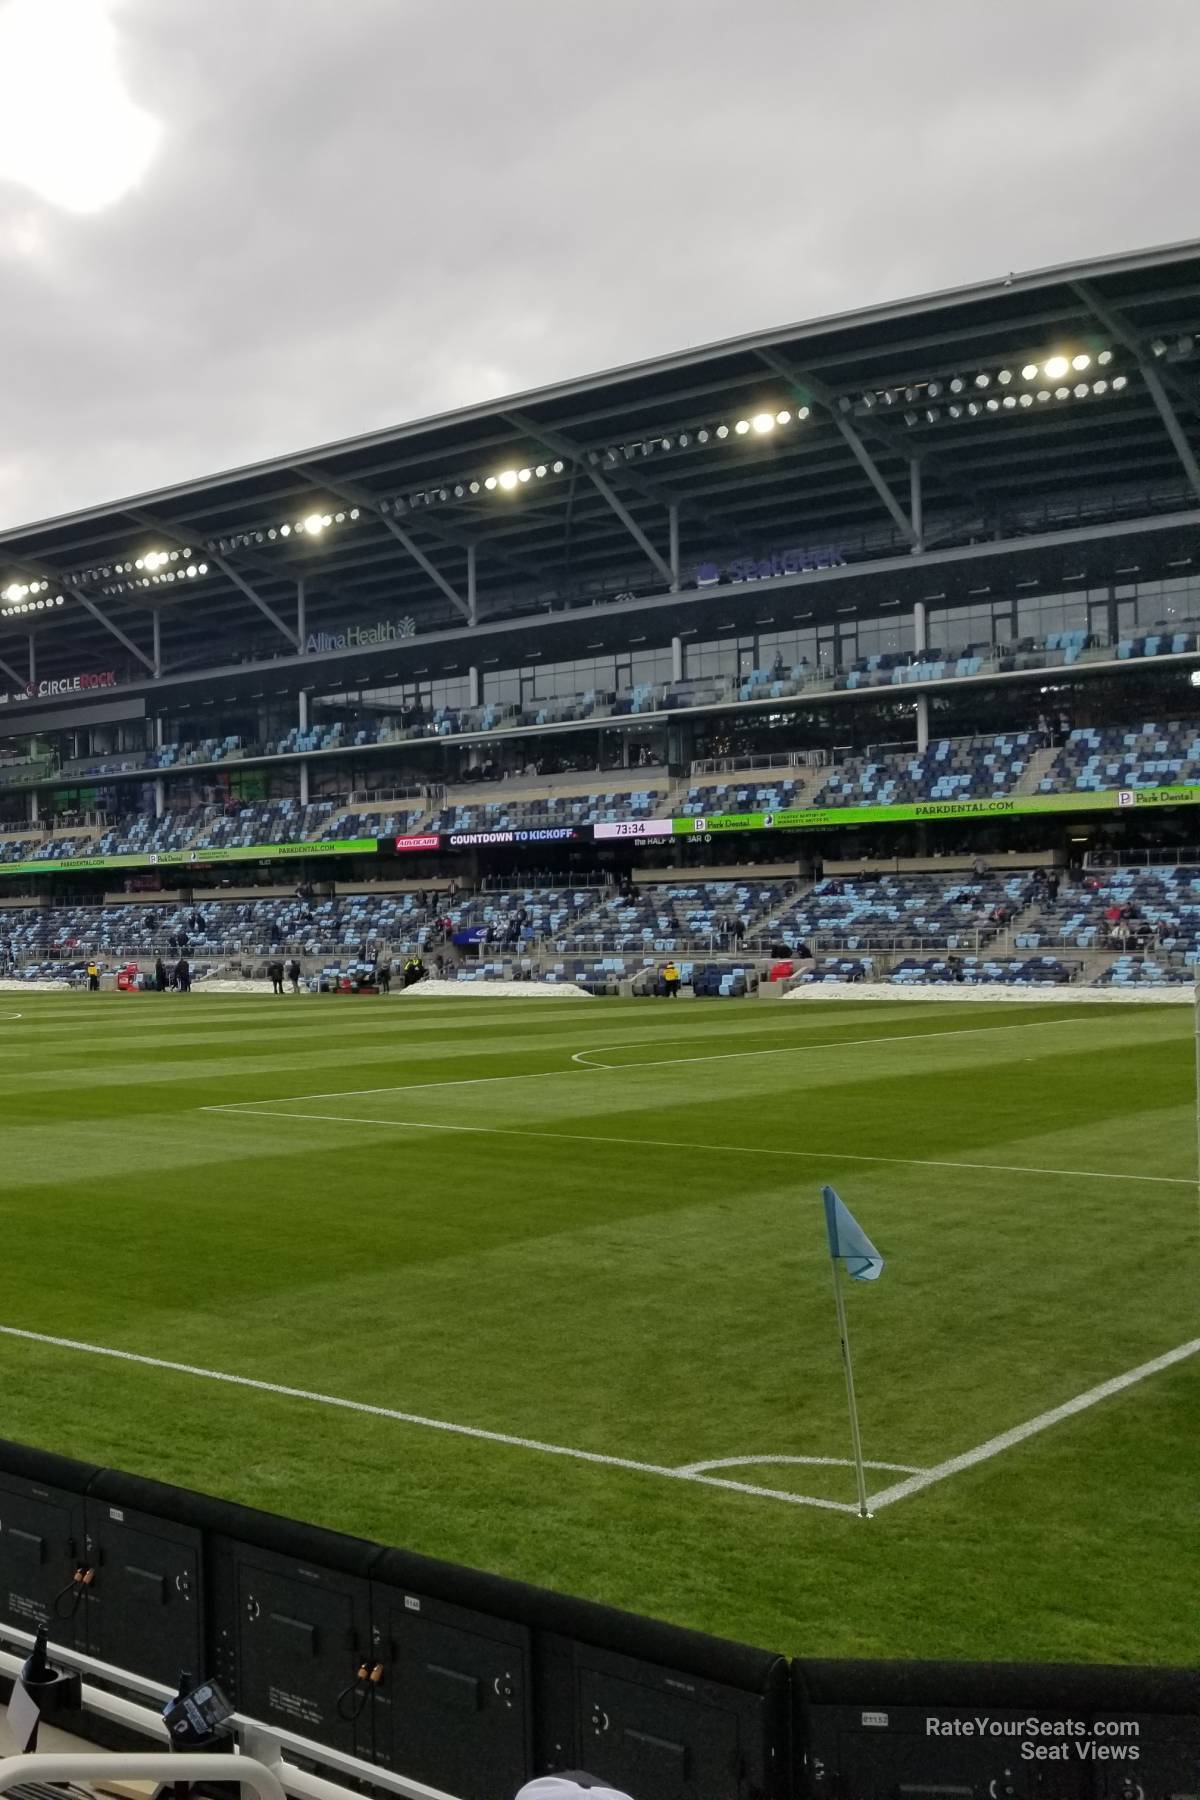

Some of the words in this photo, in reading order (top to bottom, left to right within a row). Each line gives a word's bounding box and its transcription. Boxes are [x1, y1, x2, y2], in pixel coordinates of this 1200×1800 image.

[306, 632, 347, 655] Allina
[348, 620, 397, 647] Health
[1136, 793, 1158, 804] Park
[1160, 790, 1194, 802] Dental
[915, 801, 1015, 816] PARKDENTAL.COM
[615, 823, 646, 835] 73:34
[707, 820, 723, 829] Park
[725, 818, 750, 828] Dental
[398, 837, 438, 848] ADVOCARE
[450, 832, 513, 845] COUNTDOWN
[514, 831, 528, 841] TO
[278, 844, 335, 855] PARKDENTAL.COM
[60, 859, 105, 868] PARKDENTAL.COM
